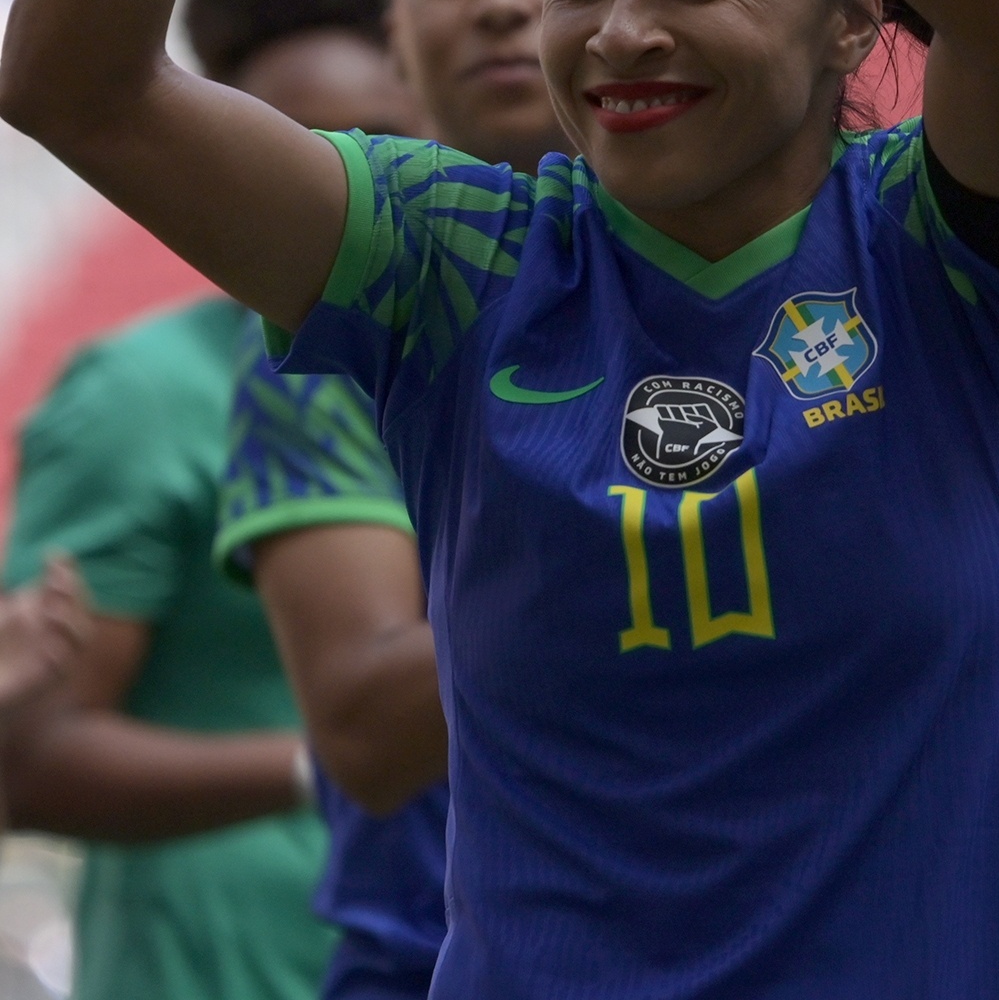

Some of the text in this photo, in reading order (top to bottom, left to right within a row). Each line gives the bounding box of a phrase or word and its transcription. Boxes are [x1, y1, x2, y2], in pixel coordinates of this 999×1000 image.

[804, 333, 838, 363] CBF
[643, 380, 744, 419] COM RACISMO
[631, 448, 726, 481] NÃO TEM JOGO
[665, 443, 690, 453] CBF
[606, 466, 777, 654] 10
